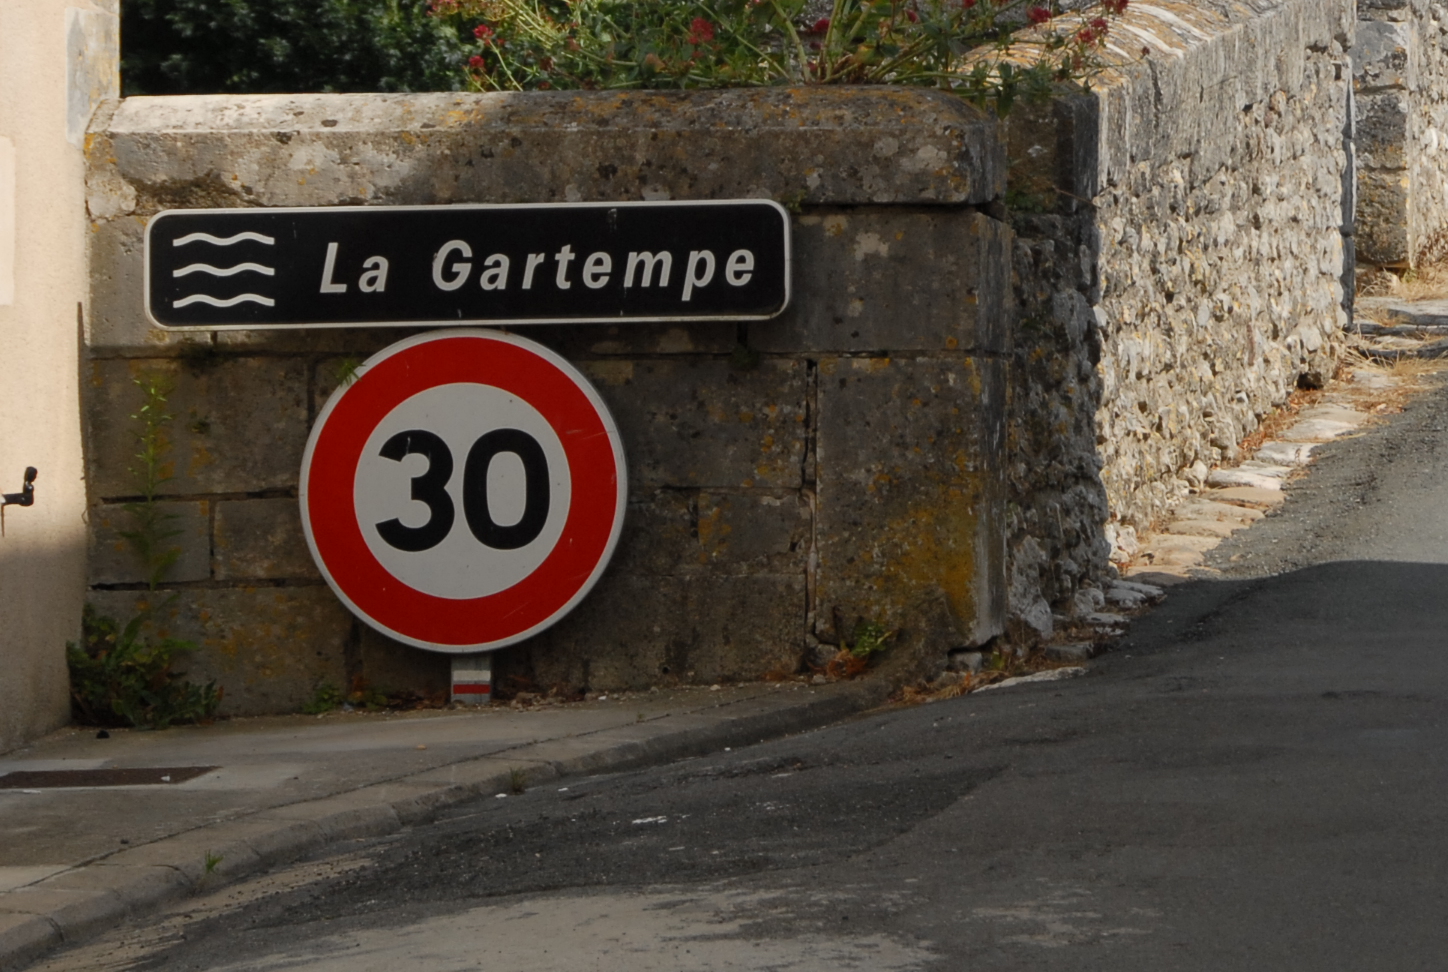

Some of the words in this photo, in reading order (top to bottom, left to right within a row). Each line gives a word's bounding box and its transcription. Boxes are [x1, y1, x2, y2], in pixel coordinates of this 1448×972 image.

[319, 242, 390, 294] La
[432, 239, 756, 301] Gartempe
[375, 428, 551, 552] 30
